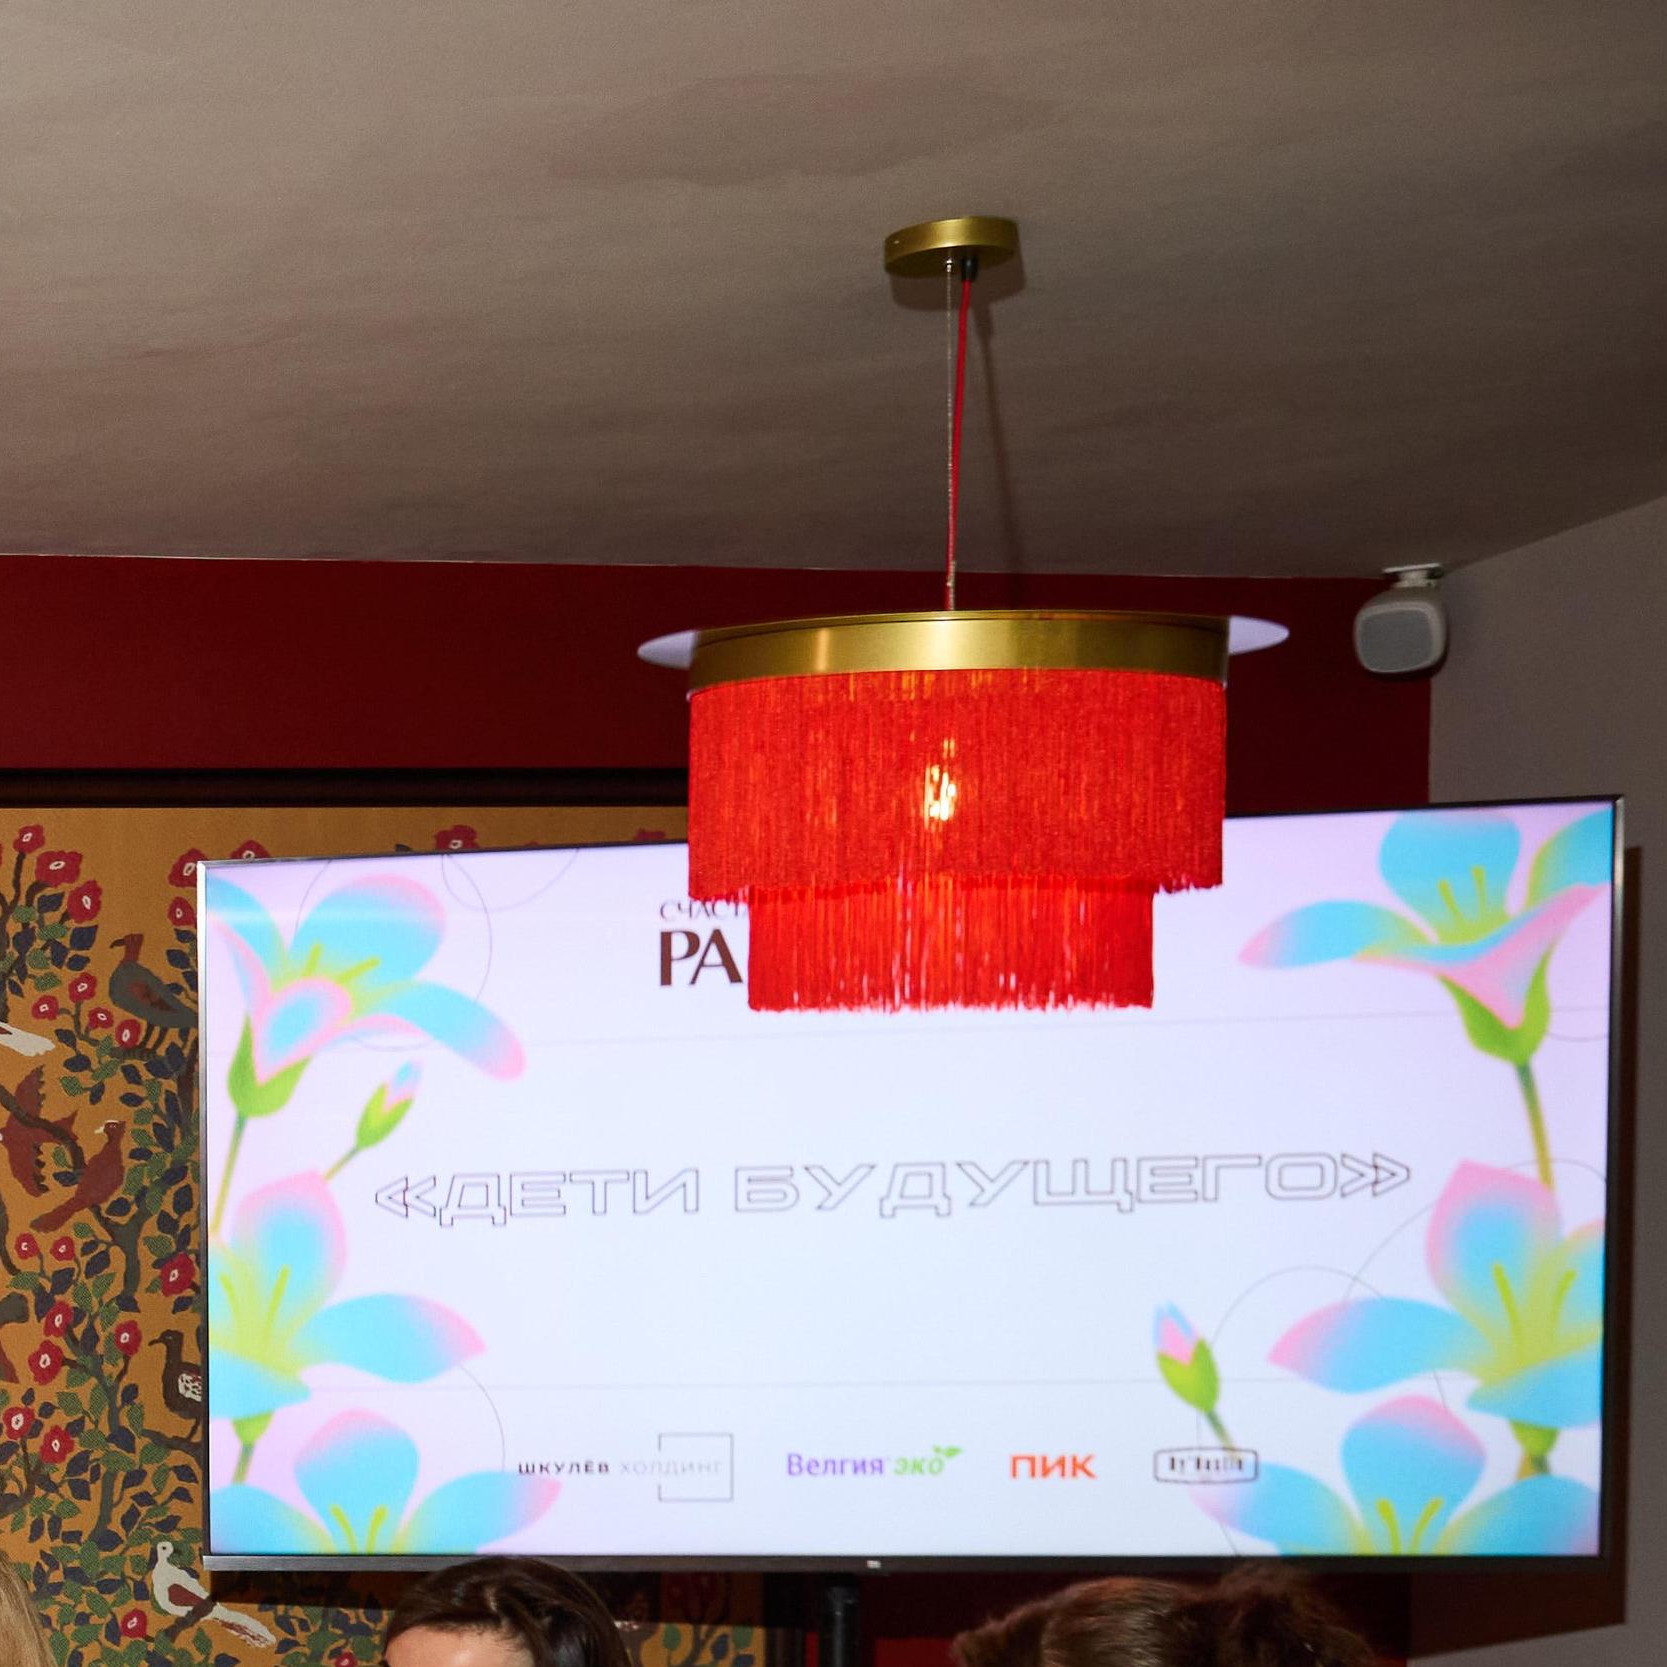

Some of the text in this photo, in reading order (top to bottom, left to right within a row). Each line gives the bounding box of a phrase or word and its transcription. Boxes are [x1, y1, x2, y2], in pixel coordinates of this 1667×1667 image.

[660, 900, 748, 919] СЧАСТ
[735, 1152, 1410, 1217] БУДУЩЕГО»
[518, 1459, 610, 1475] ШКУЛЁВ
[1010, 1454, 1096, 1479] ПИК
